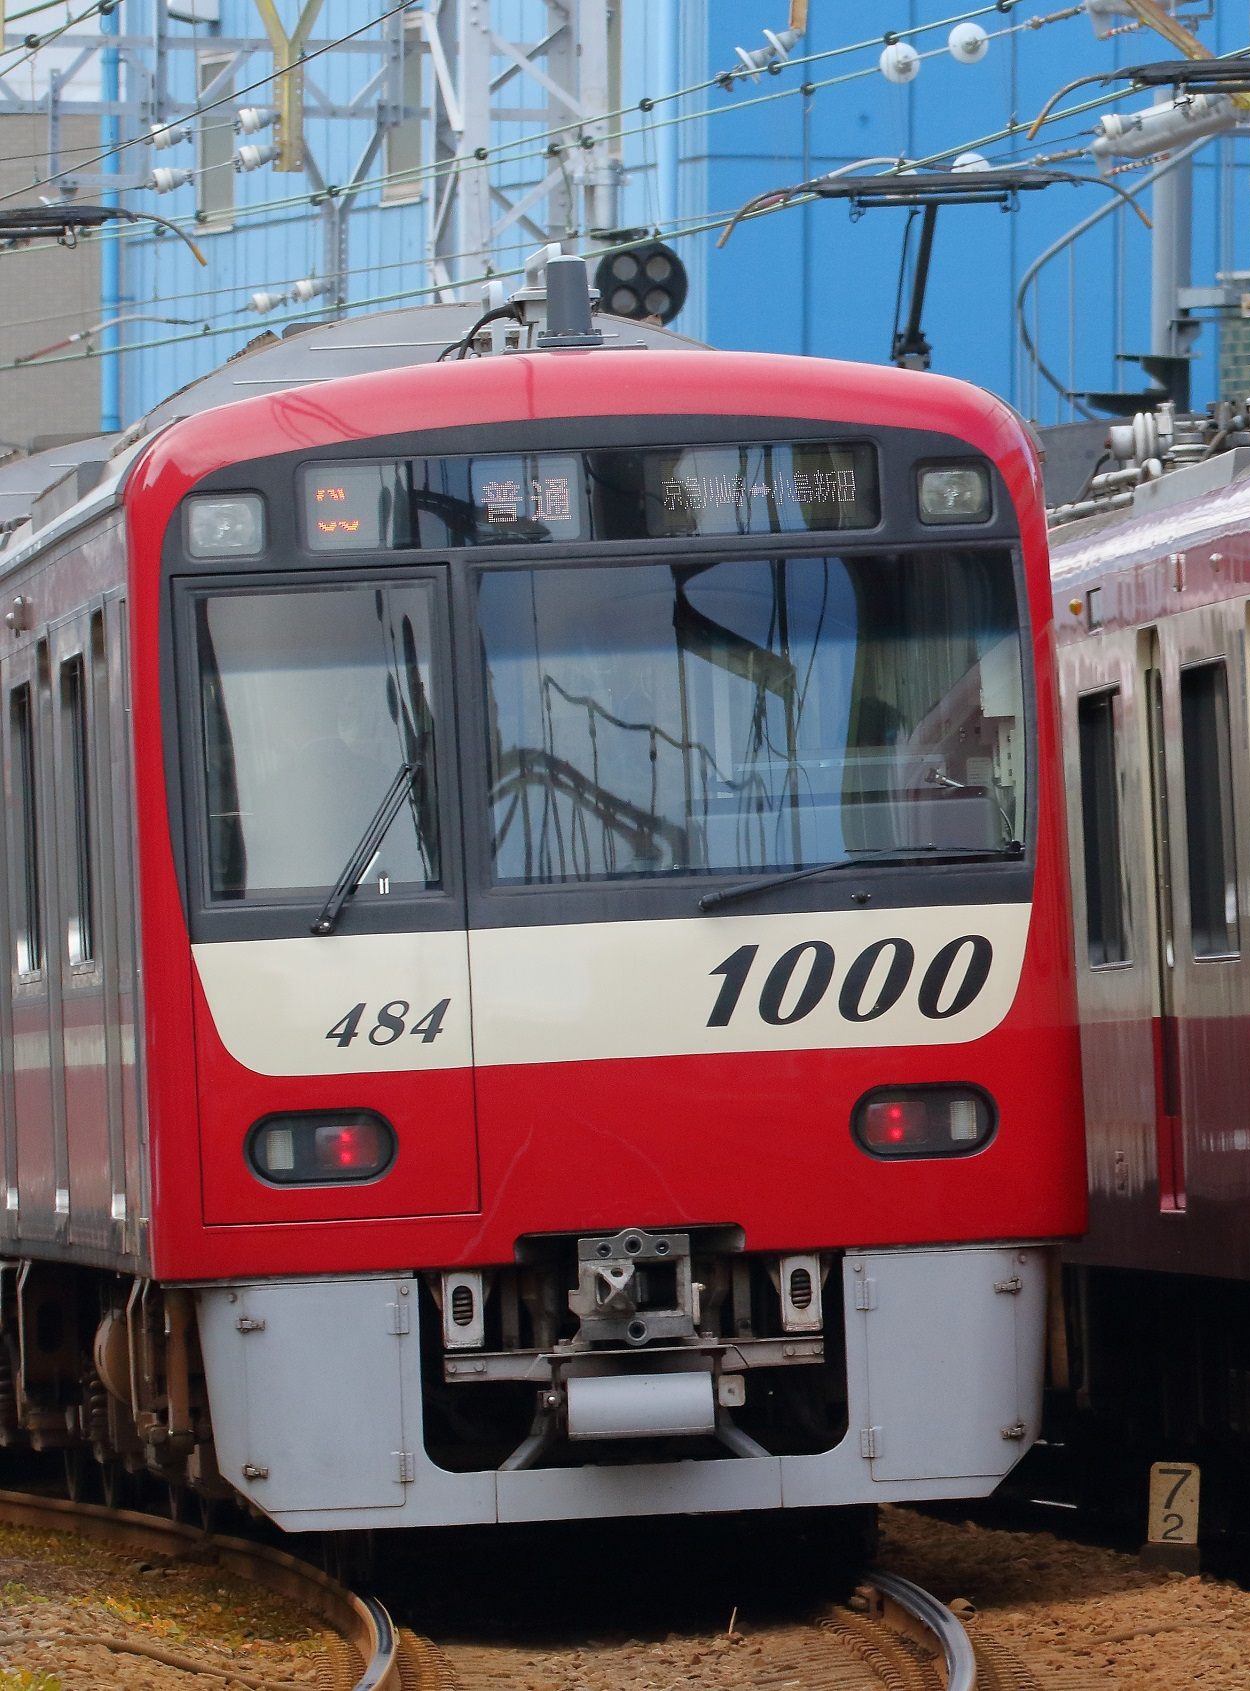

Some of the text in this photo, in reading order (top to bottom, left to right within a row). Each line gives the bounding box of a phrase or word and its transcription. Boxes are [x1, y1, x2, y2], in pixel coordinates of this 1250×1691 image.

[481, 478, 572, 523] 普通
[705, 934, 994, 1028] 1000
[325, 998, 452, 1048] 484
[1158, 1469, 1192, 1510] 7
[1161, 1513, 1184, 1541] 2
